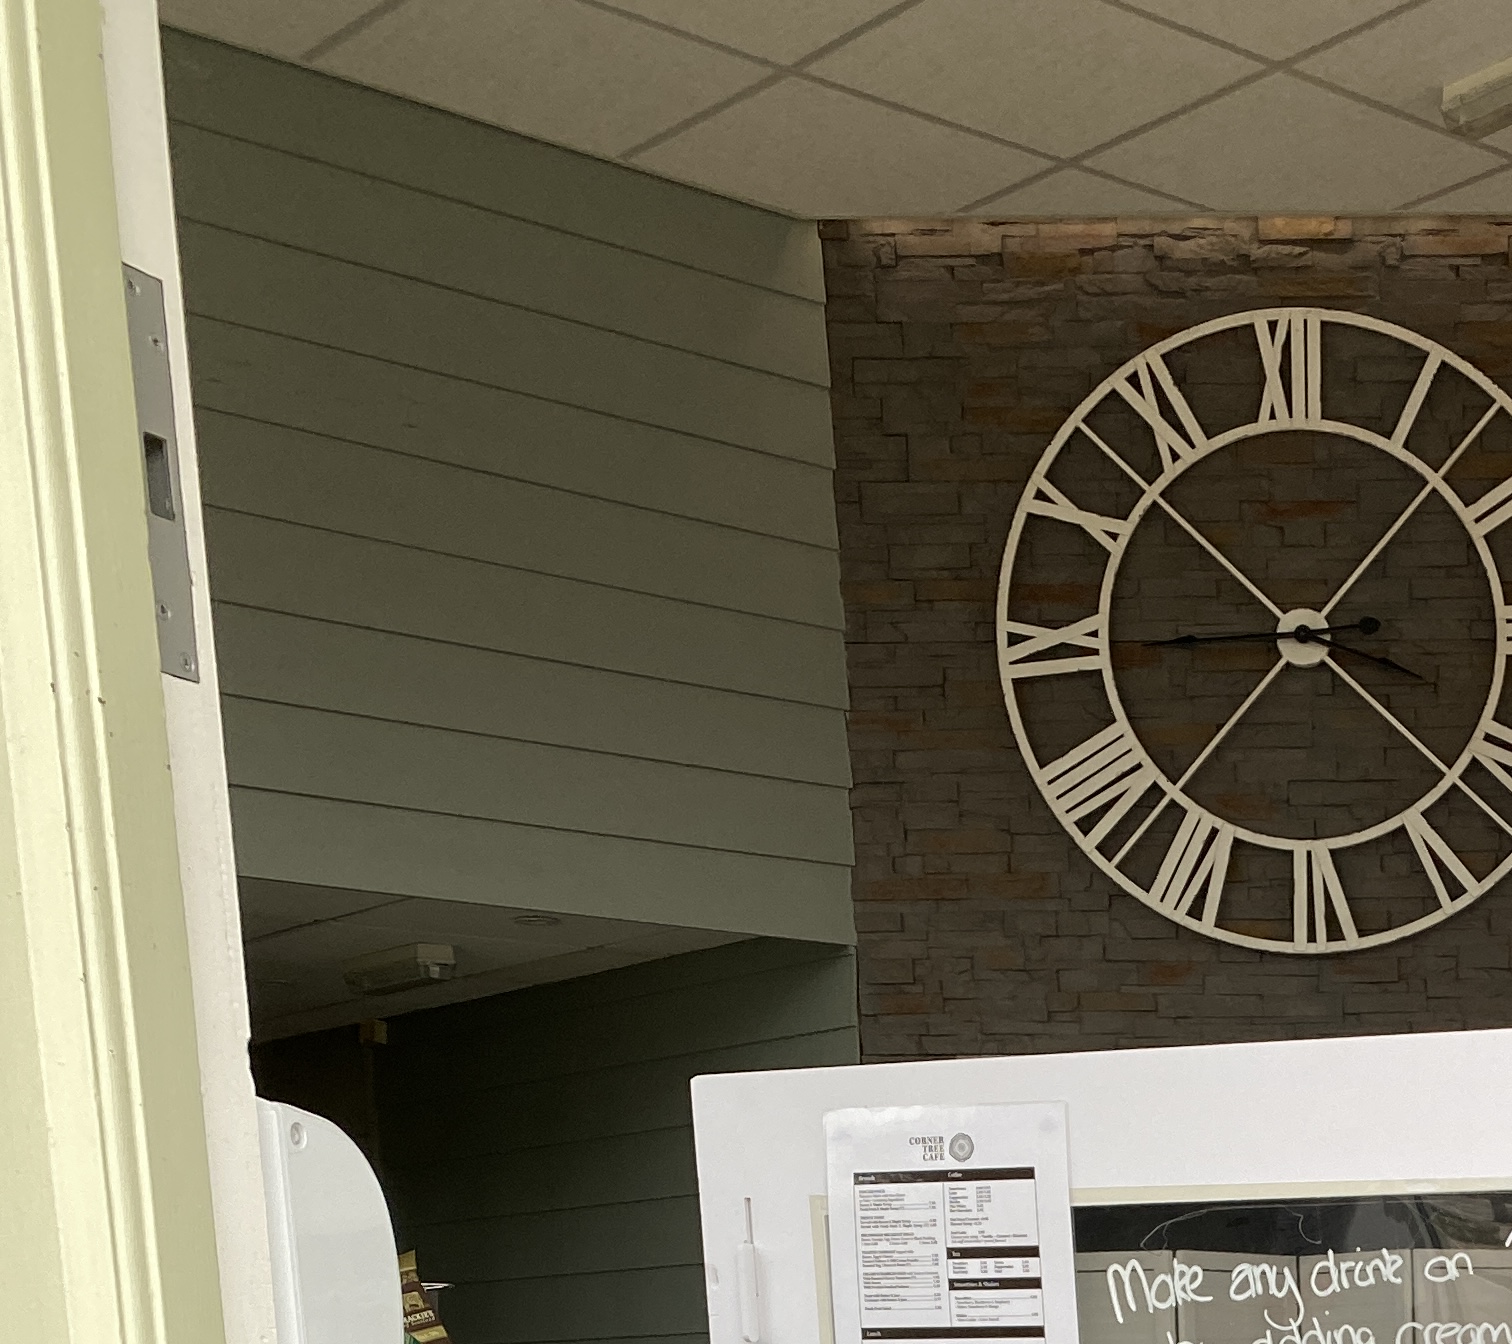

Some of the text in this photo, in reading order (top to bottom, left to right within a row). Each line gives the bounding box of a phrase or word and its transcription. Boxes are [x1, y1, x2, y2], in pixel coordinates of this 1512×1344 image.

[1106, 1258, 1213, 1323] Make
[1229, 1261, 1305, 1331] any
[1310, 1247, 1404, 1298] drink
